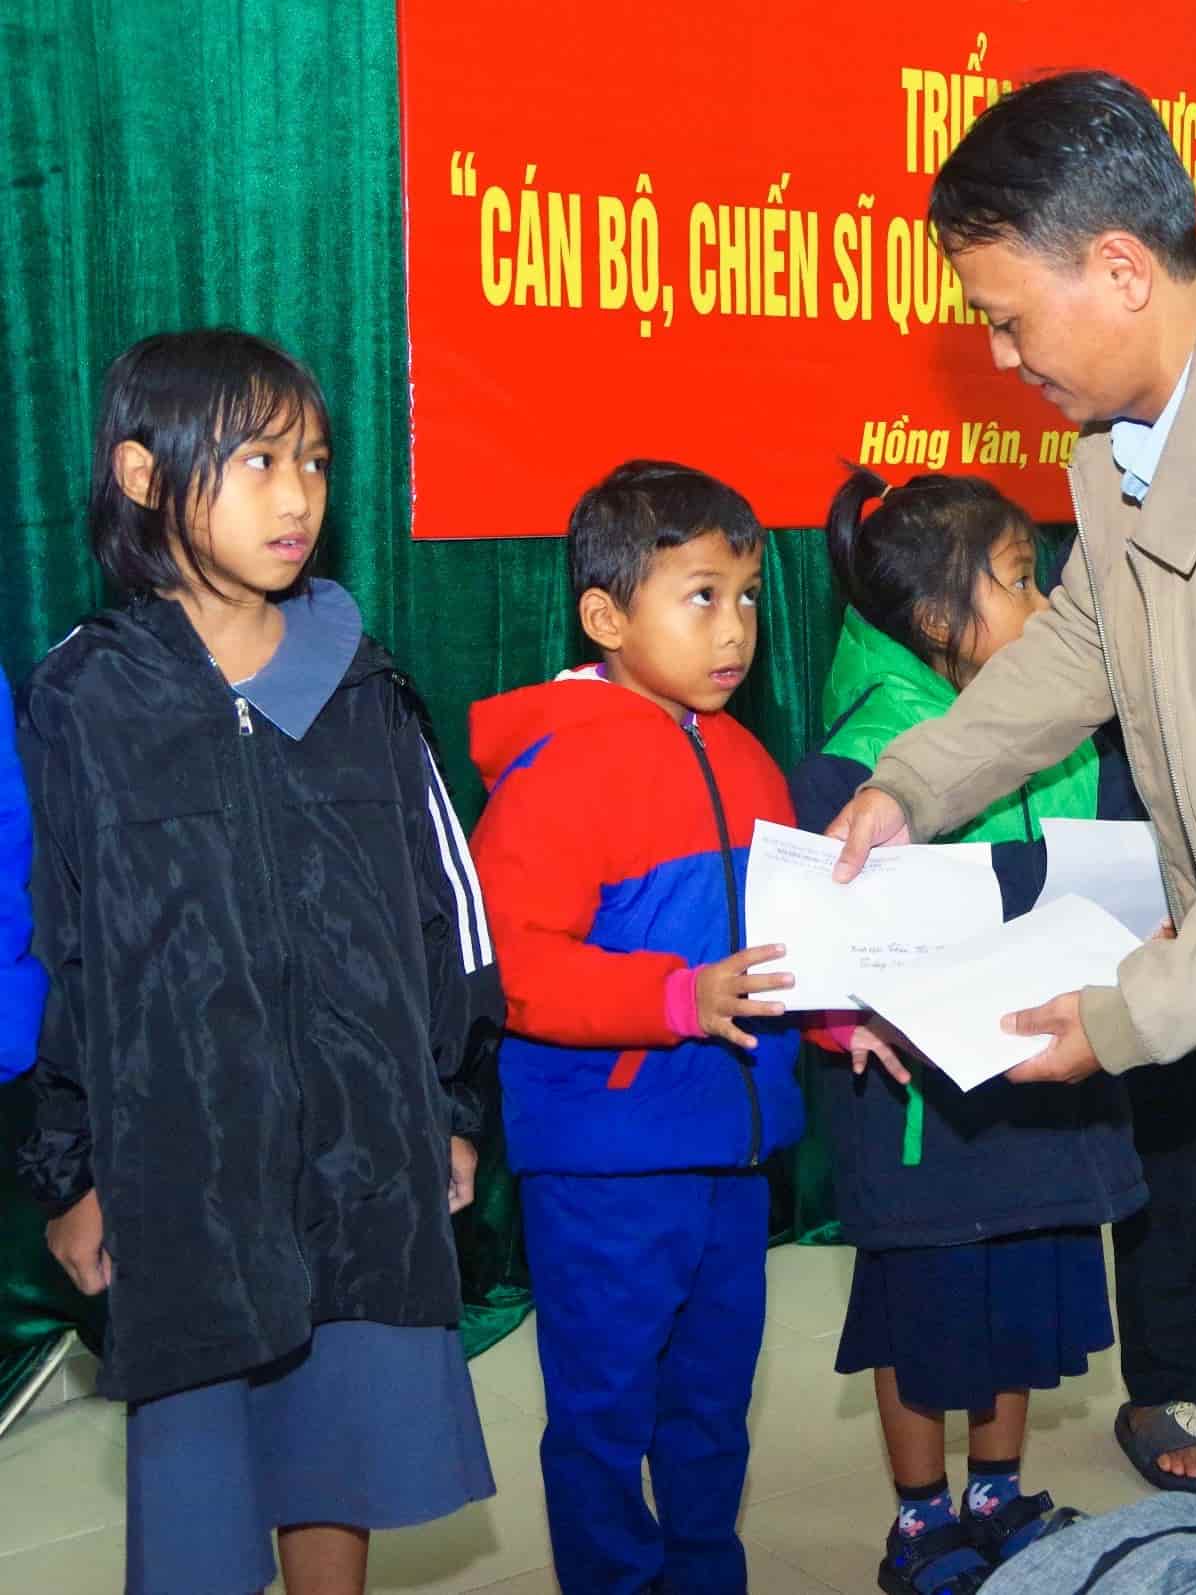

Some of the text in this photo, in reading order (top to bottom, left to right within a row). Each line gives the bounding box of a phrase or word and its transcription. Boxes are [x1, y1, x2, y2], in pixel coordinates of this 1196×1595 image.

[901, 31, 1013, 174] TRIỂ
[597, 173, 674, 338] BỘ,
[689, 172, 818, 319] CHIẾN
[832, 192, 875, 321] SĨ
[859, 414, 950, 470] Hồng
[961, 421, 1028, 469] Vân,
